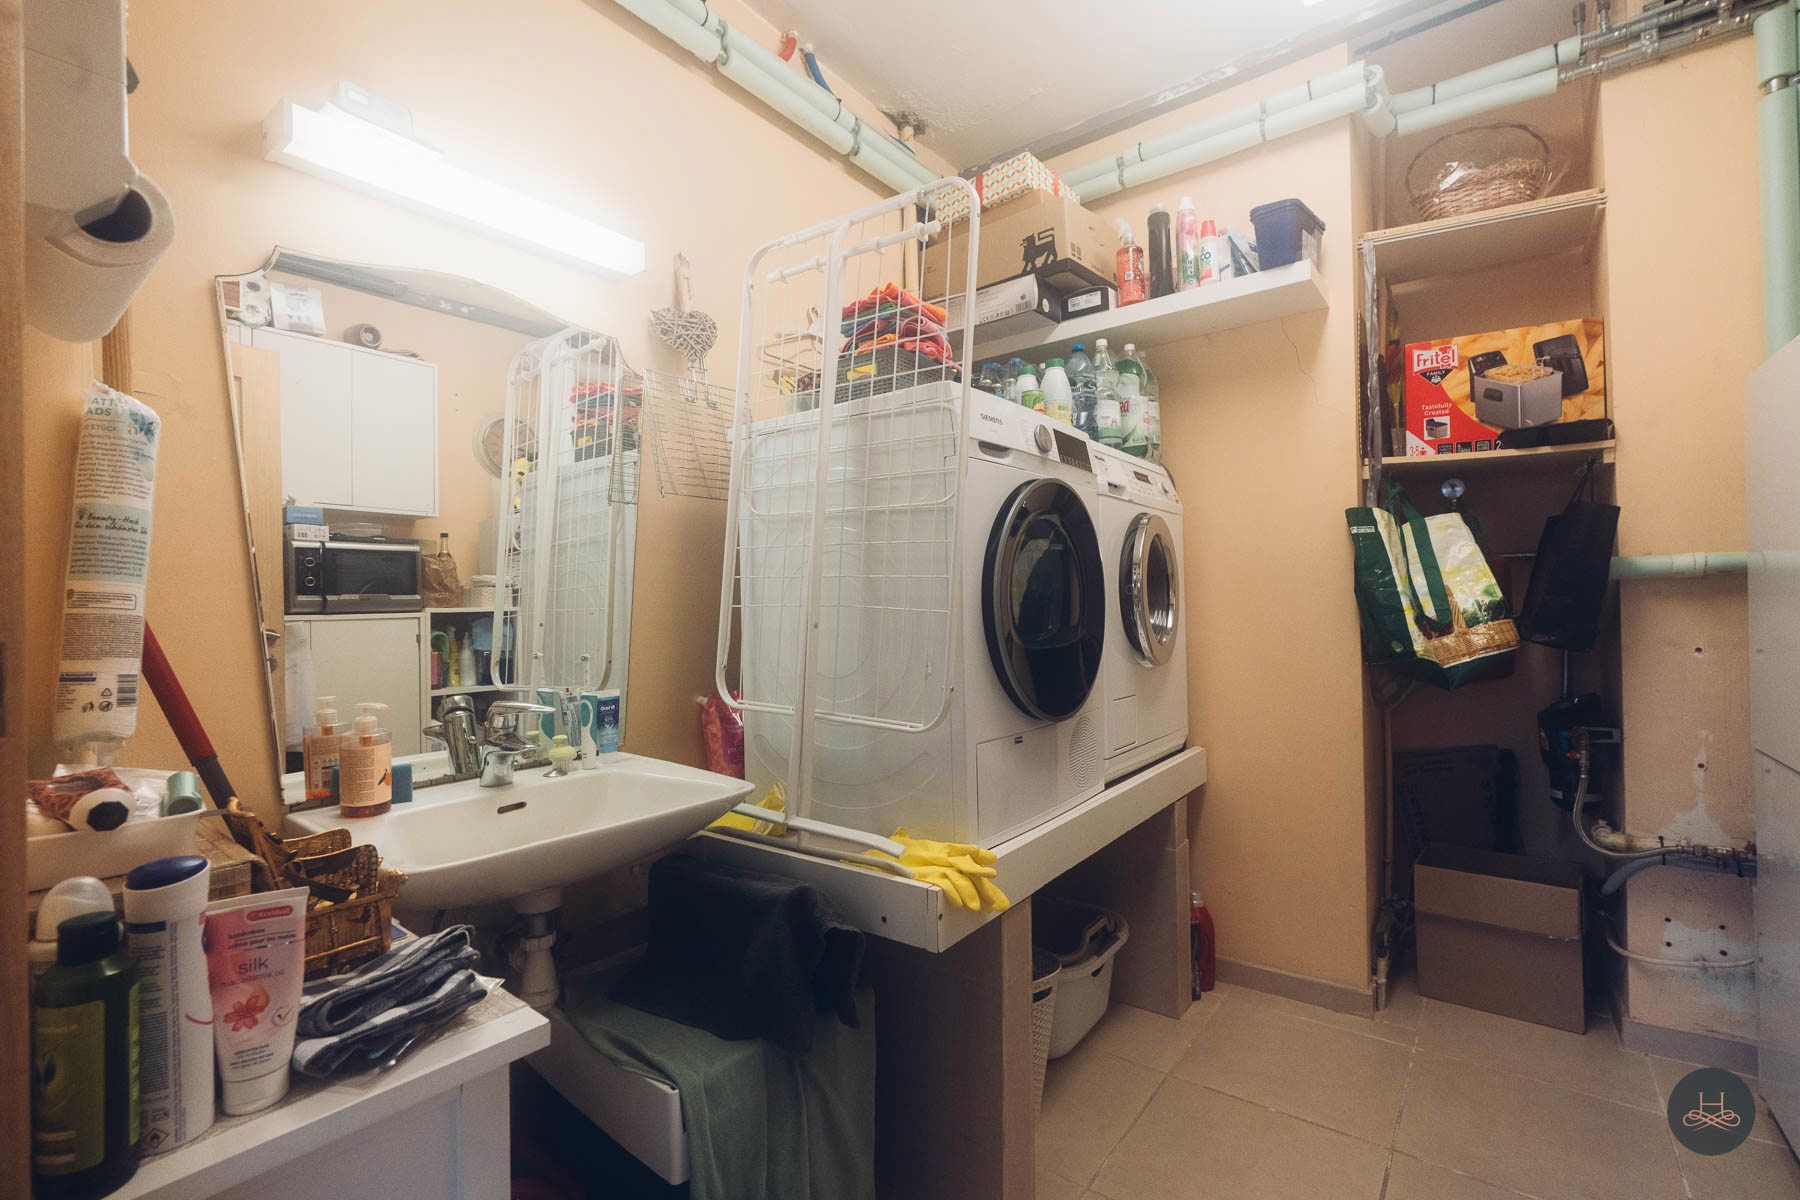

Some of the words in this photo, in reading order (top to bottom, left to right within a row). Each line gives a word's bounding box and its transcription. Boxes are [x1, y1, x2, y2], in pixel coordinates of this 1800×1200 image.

[1416, 349, 1456, 368] fritel
[1421, 402, 1453, 411] Tastefully
[1424, 408, 1450, 416] Created
[238, 956, 270, 975] silk
